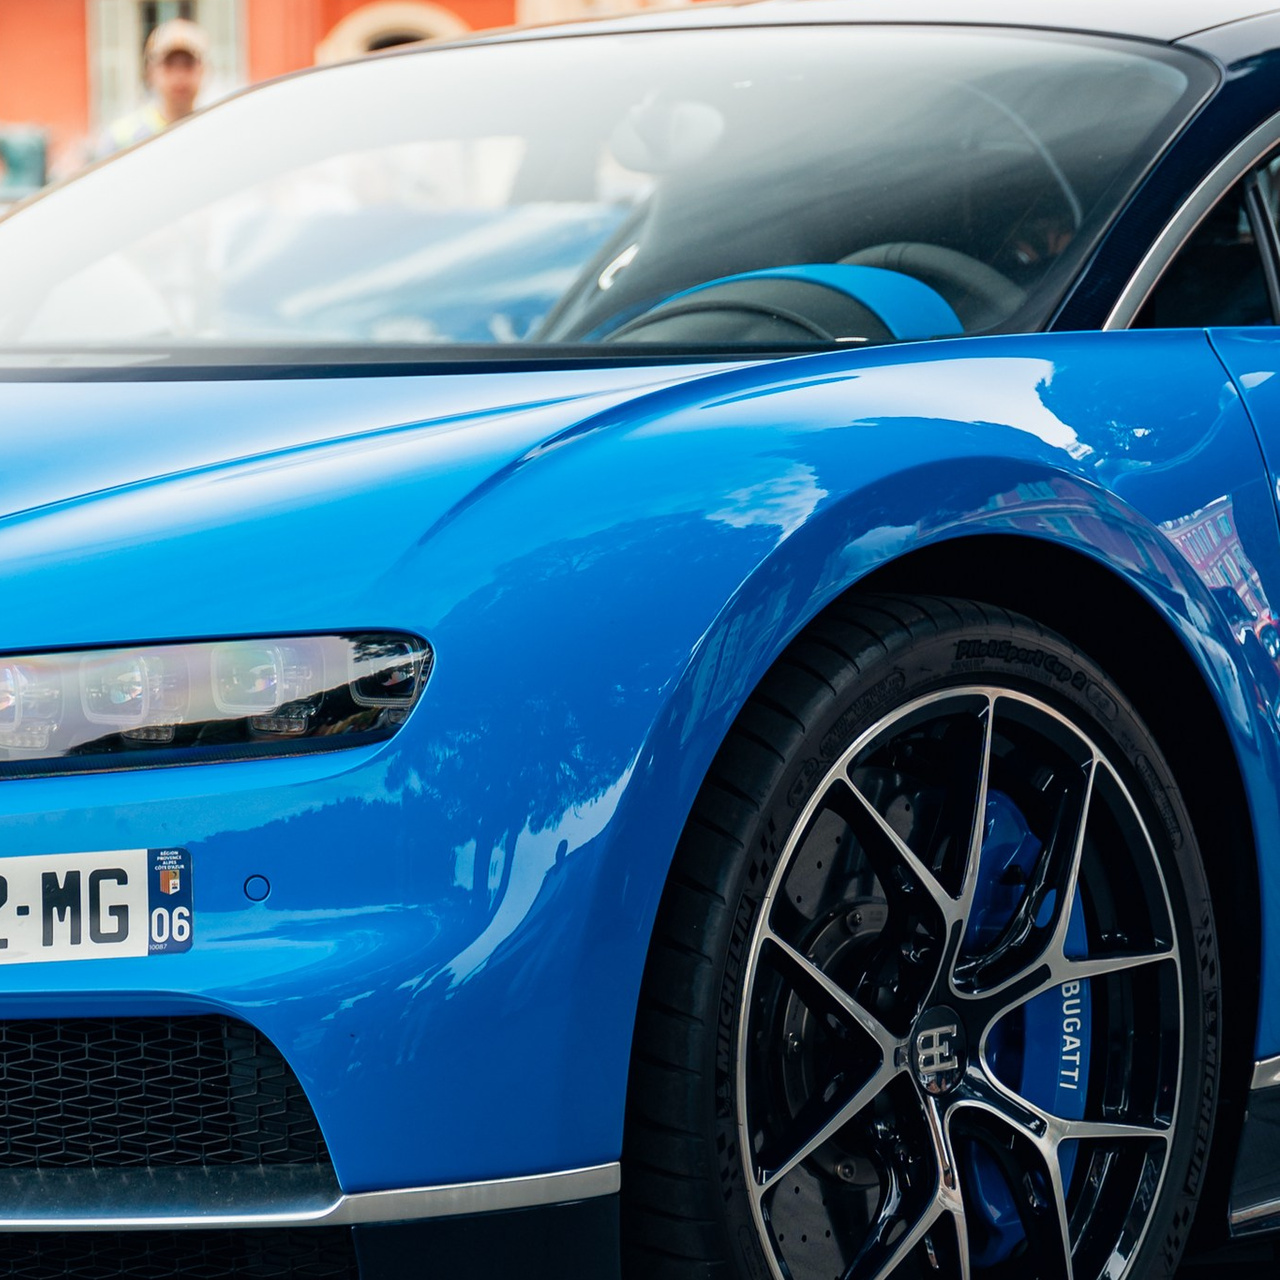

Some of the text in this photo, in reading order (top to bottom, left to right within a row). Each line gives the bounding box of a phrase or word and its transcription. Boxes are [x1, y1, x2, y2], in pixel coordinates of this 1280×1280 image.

[1072, 670, 1087, 691] 2
[151, 906, 190, 943] 06
[717, 893, 757, 1070] MICHELIN
[1059, 980, 1081, 1090] BUGATTI
[1184, 1034, 1219, 1197] MICHELIN
